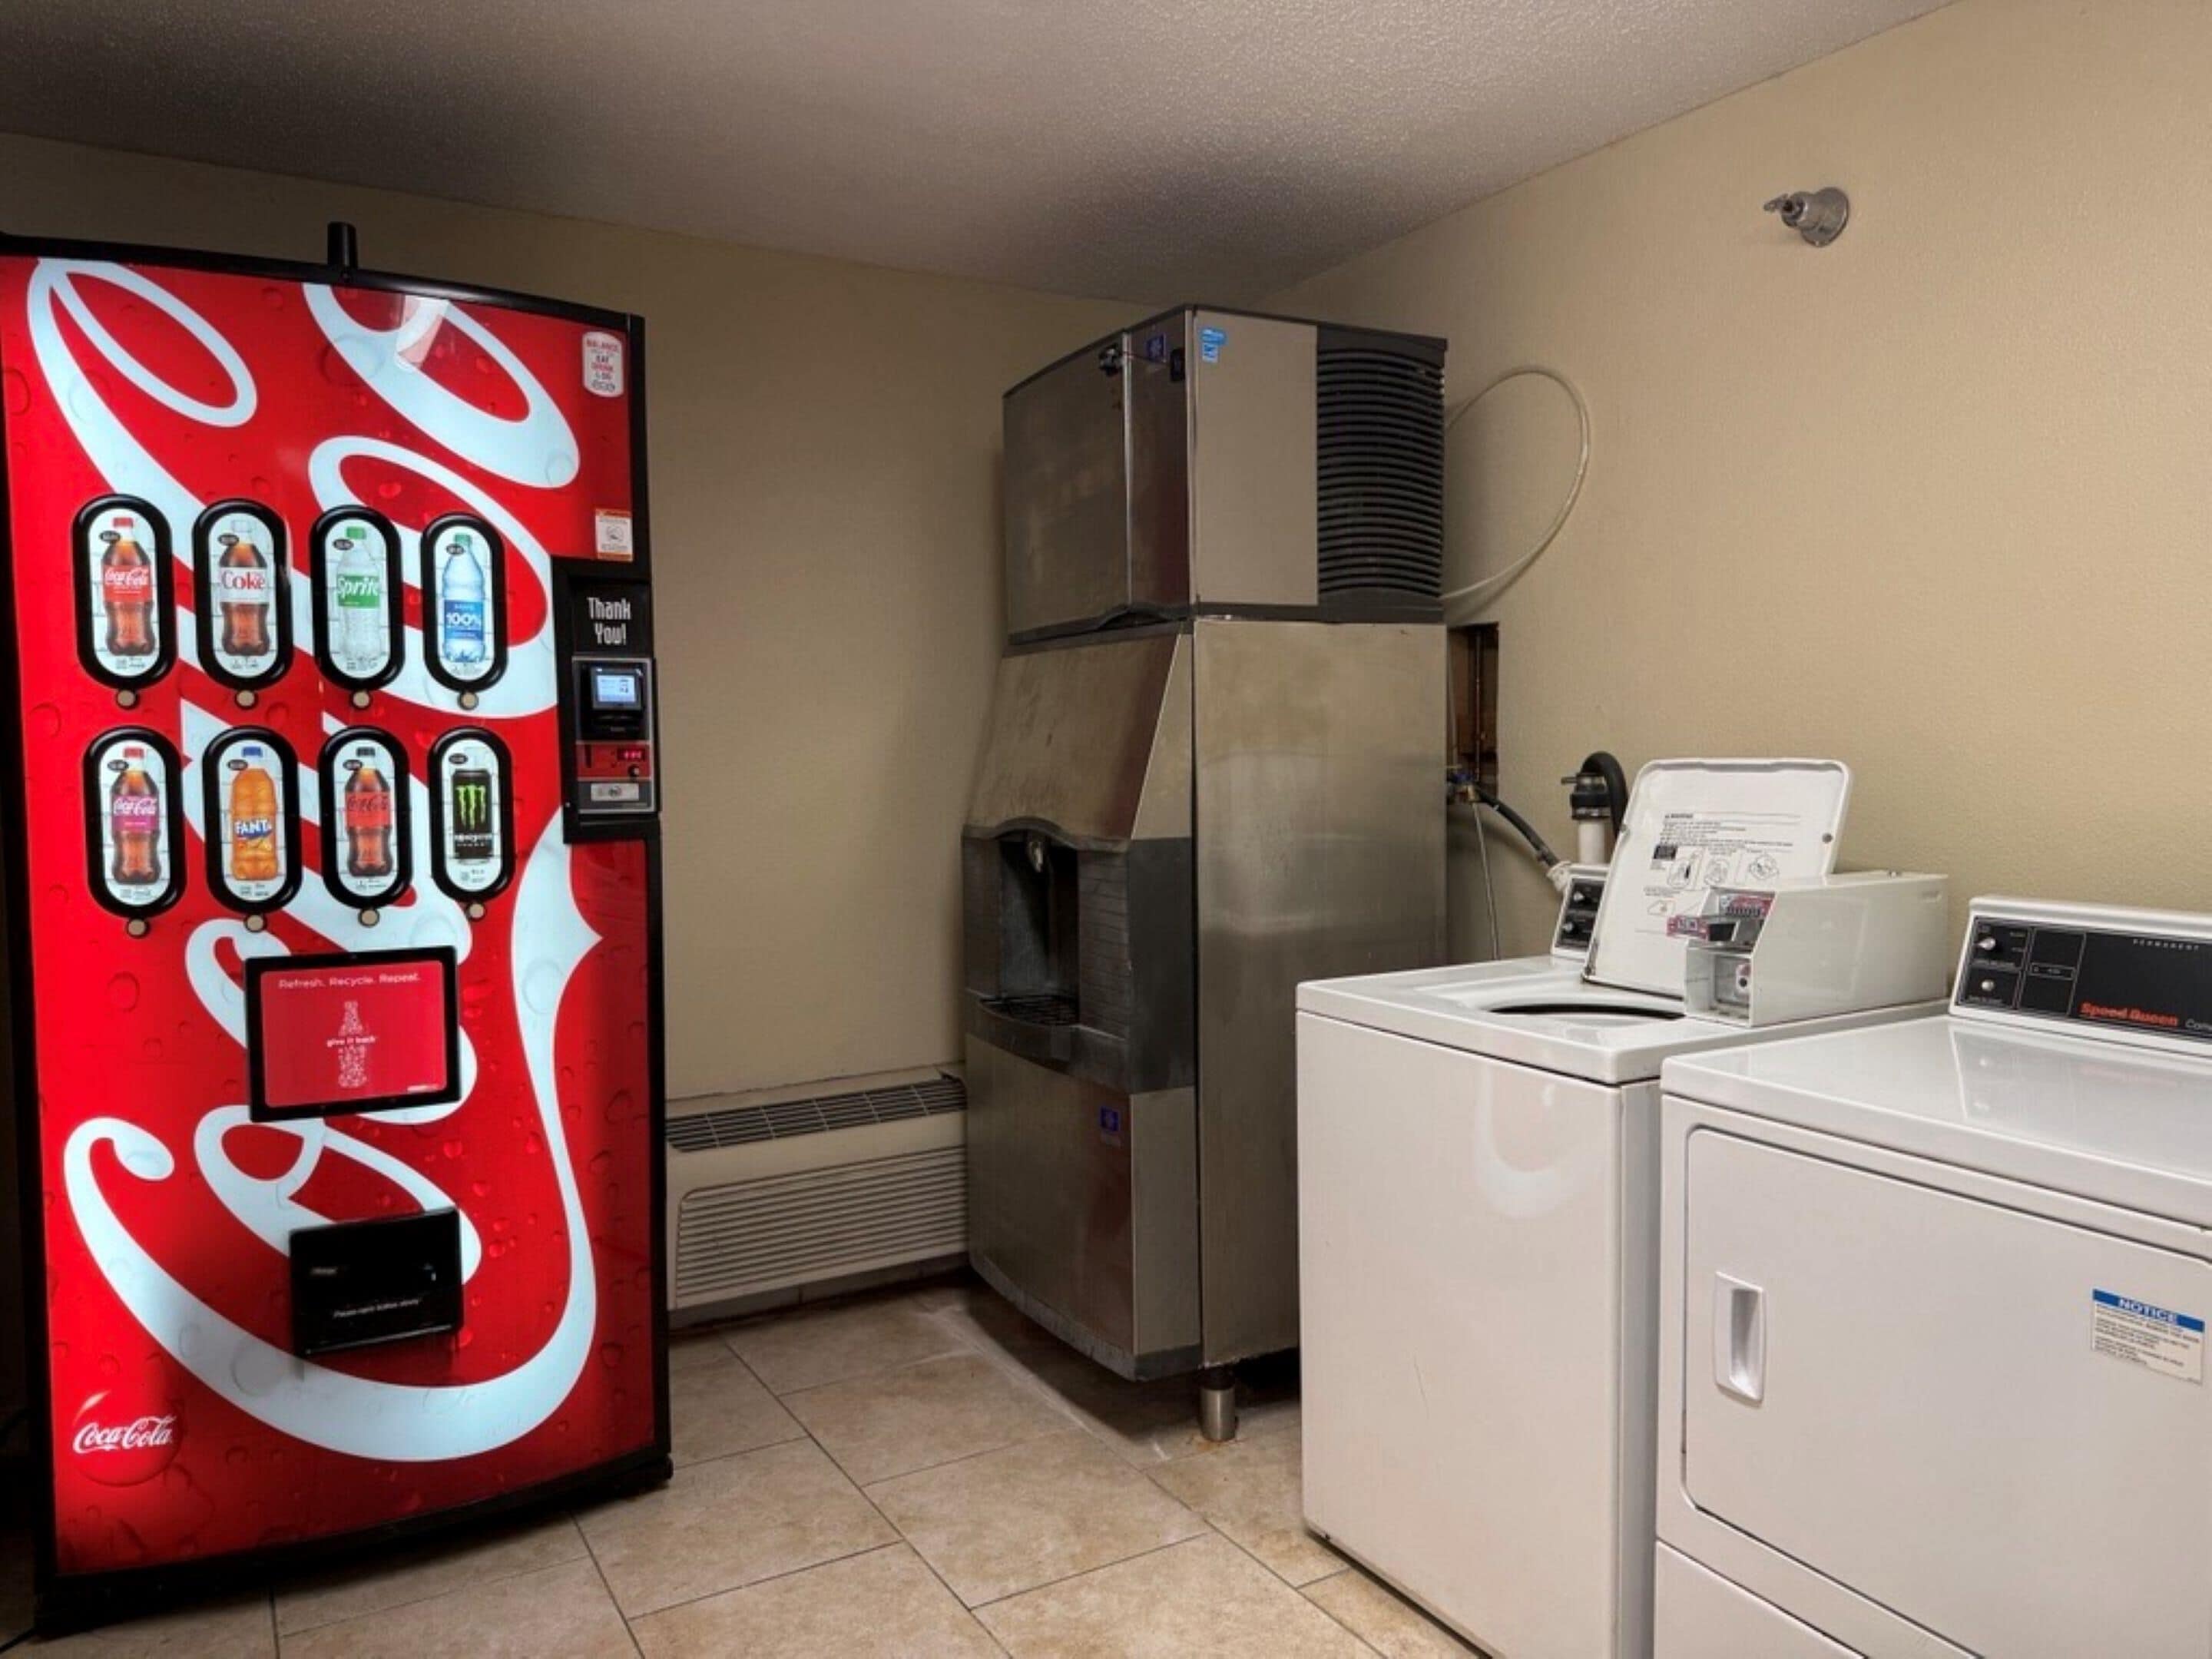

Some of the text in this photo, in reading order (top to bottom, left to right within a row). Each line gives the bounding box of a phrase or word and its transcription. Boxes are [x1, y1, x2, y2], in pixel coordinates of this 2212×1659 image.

[221, 571, 265, 590] Coke
[587, 597, 632, 620] Thank
[594, 623, 627, 645] You!
[278, 972, 421, 990] Refresh. Recycle. Repeat.
[2081, 1002, 2128, 1019] Speed
[2128, 1008, 2179, 1027] Queen
[2118, 1297, 2178, 1325] NOTICE
[72, 1413, 177, 1455] Coca-Cola
